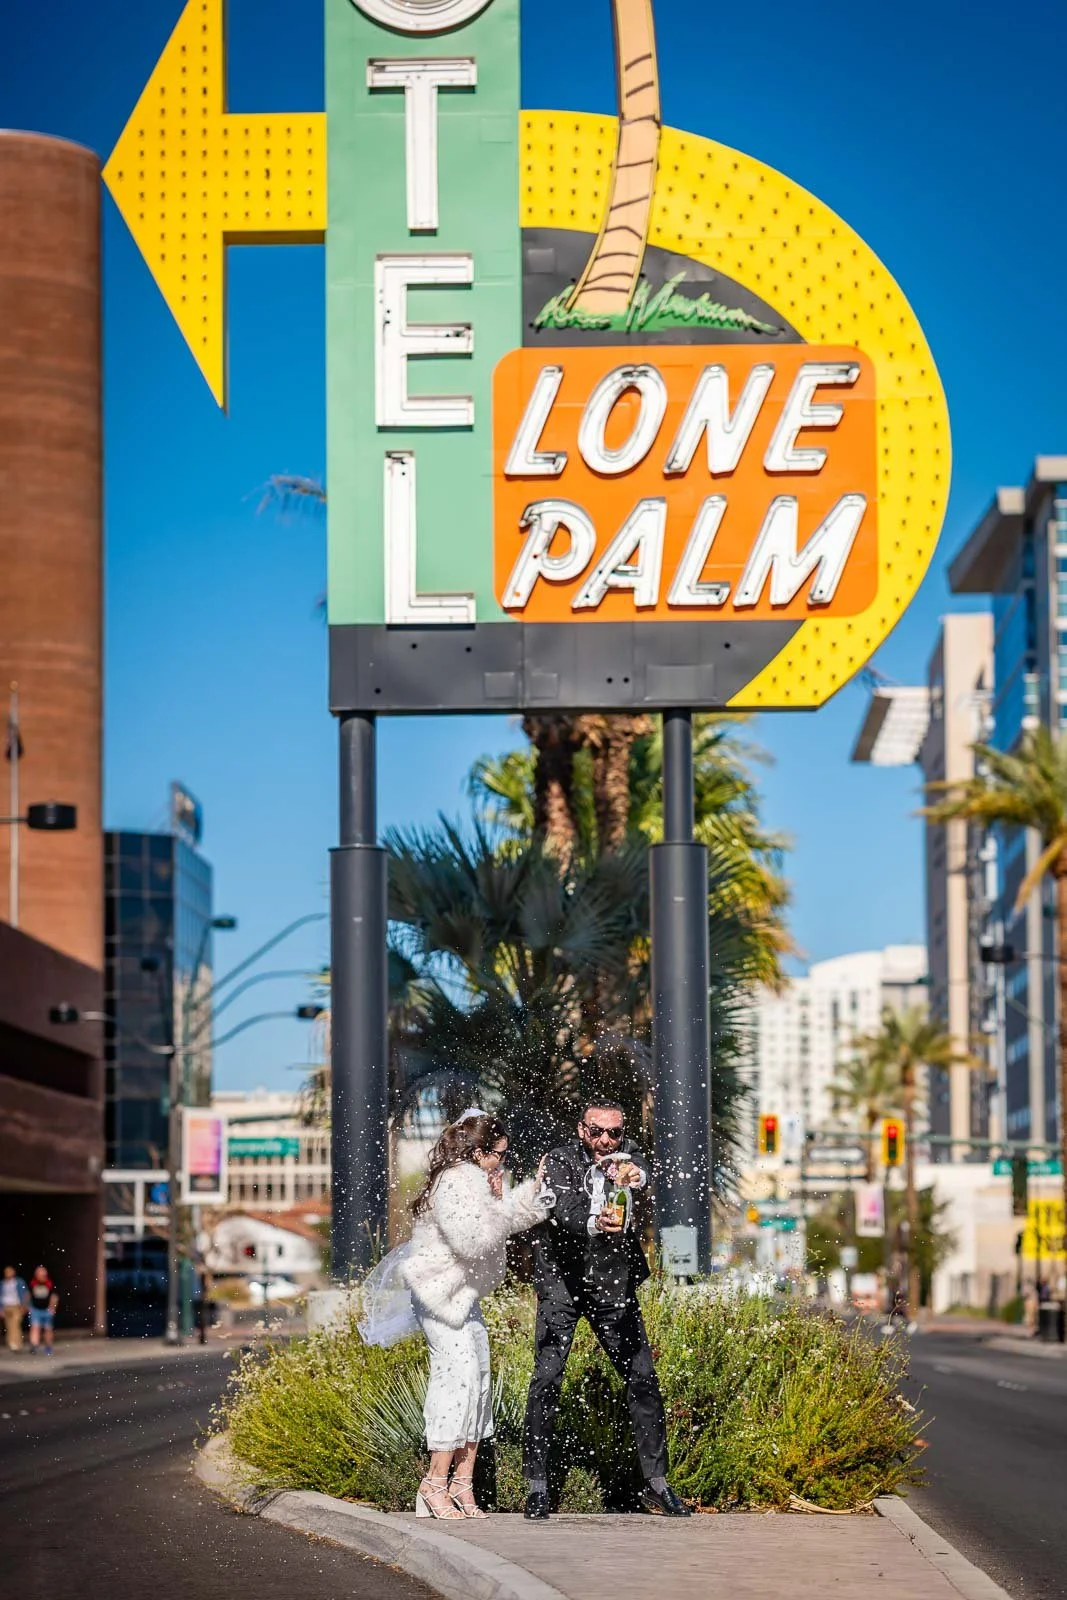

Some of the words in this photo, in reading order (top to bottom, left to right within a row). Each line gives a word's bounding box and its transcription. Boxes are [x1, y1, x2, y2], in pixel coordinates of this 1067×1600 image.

[349, 0, 494, 627] TEL
[504, 363, 860, 476] LONE
[502, 494, 867, 609] PALM
